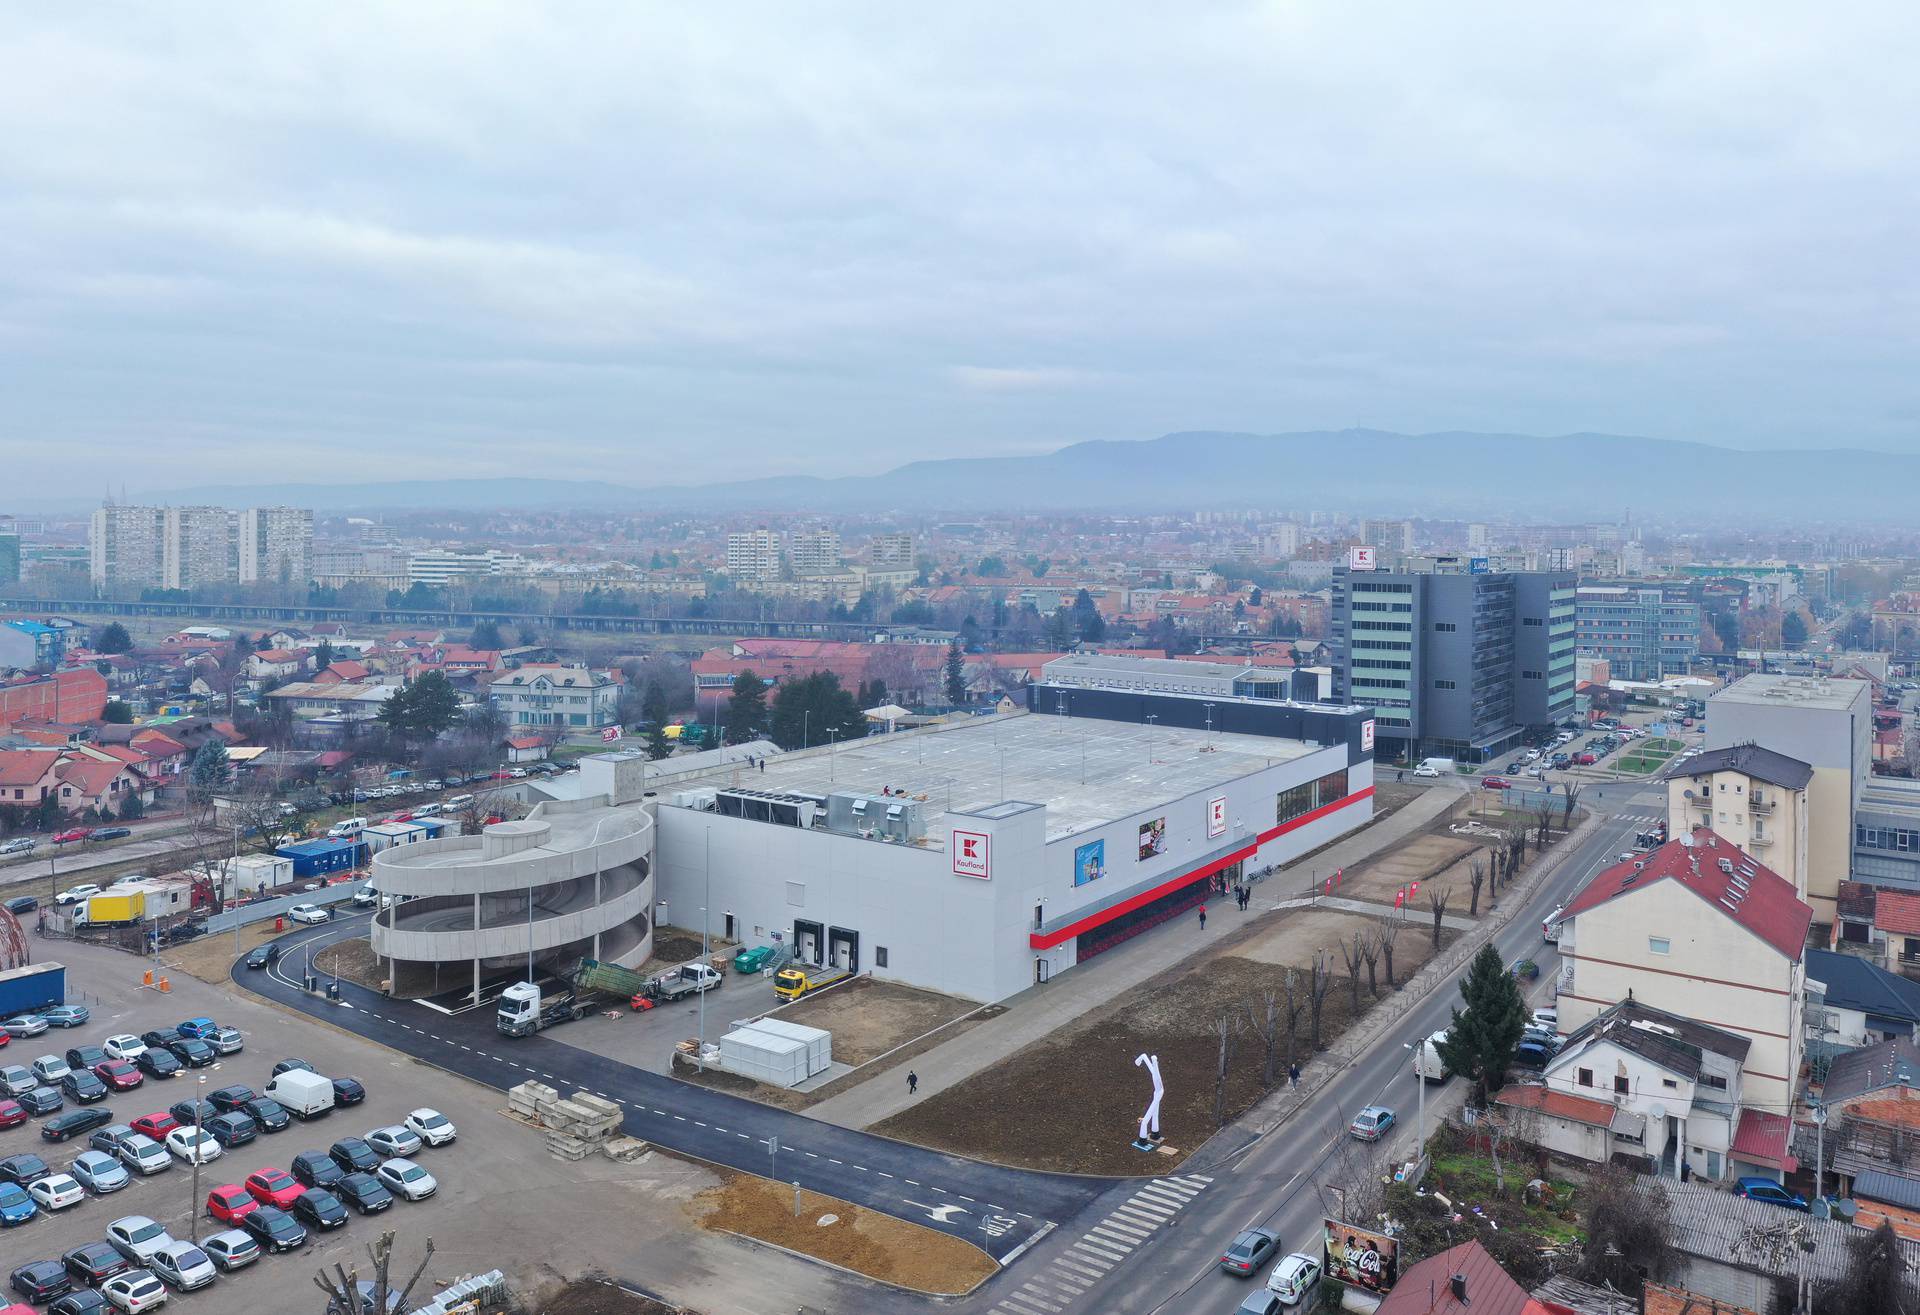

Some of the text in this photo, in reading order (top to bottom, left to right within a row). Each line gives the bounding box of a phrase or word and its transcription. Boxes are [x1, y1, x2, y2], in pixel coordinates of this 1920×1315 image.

[1359, 551, 1368, 561] K
[1215, 804, 1222, 820] K
[963, 839, 978, 858] K
[957, 859, 985, 870] Kaufland
[978, 1215, 1018, 1237] STOP
